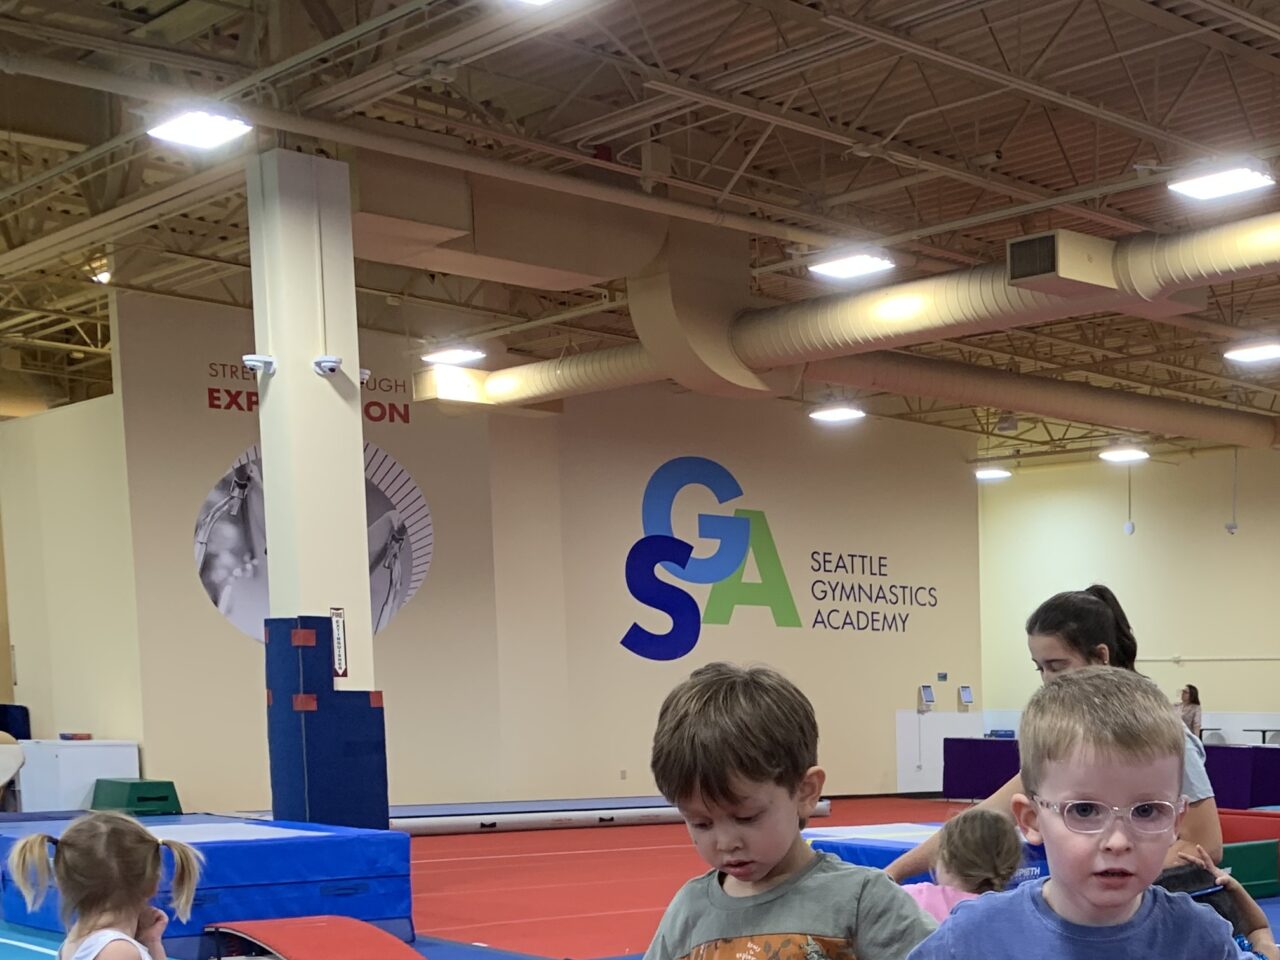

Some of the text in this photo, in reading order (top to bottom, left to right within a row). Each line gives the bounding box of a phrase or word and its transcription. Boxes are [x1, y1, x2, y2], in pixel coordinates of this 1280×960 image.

[810, 550, 888, 577] SEATTLE
[811, 579, 938, 608] GYMNASTICS
[811, 608, 910, 633] ACADEMY
